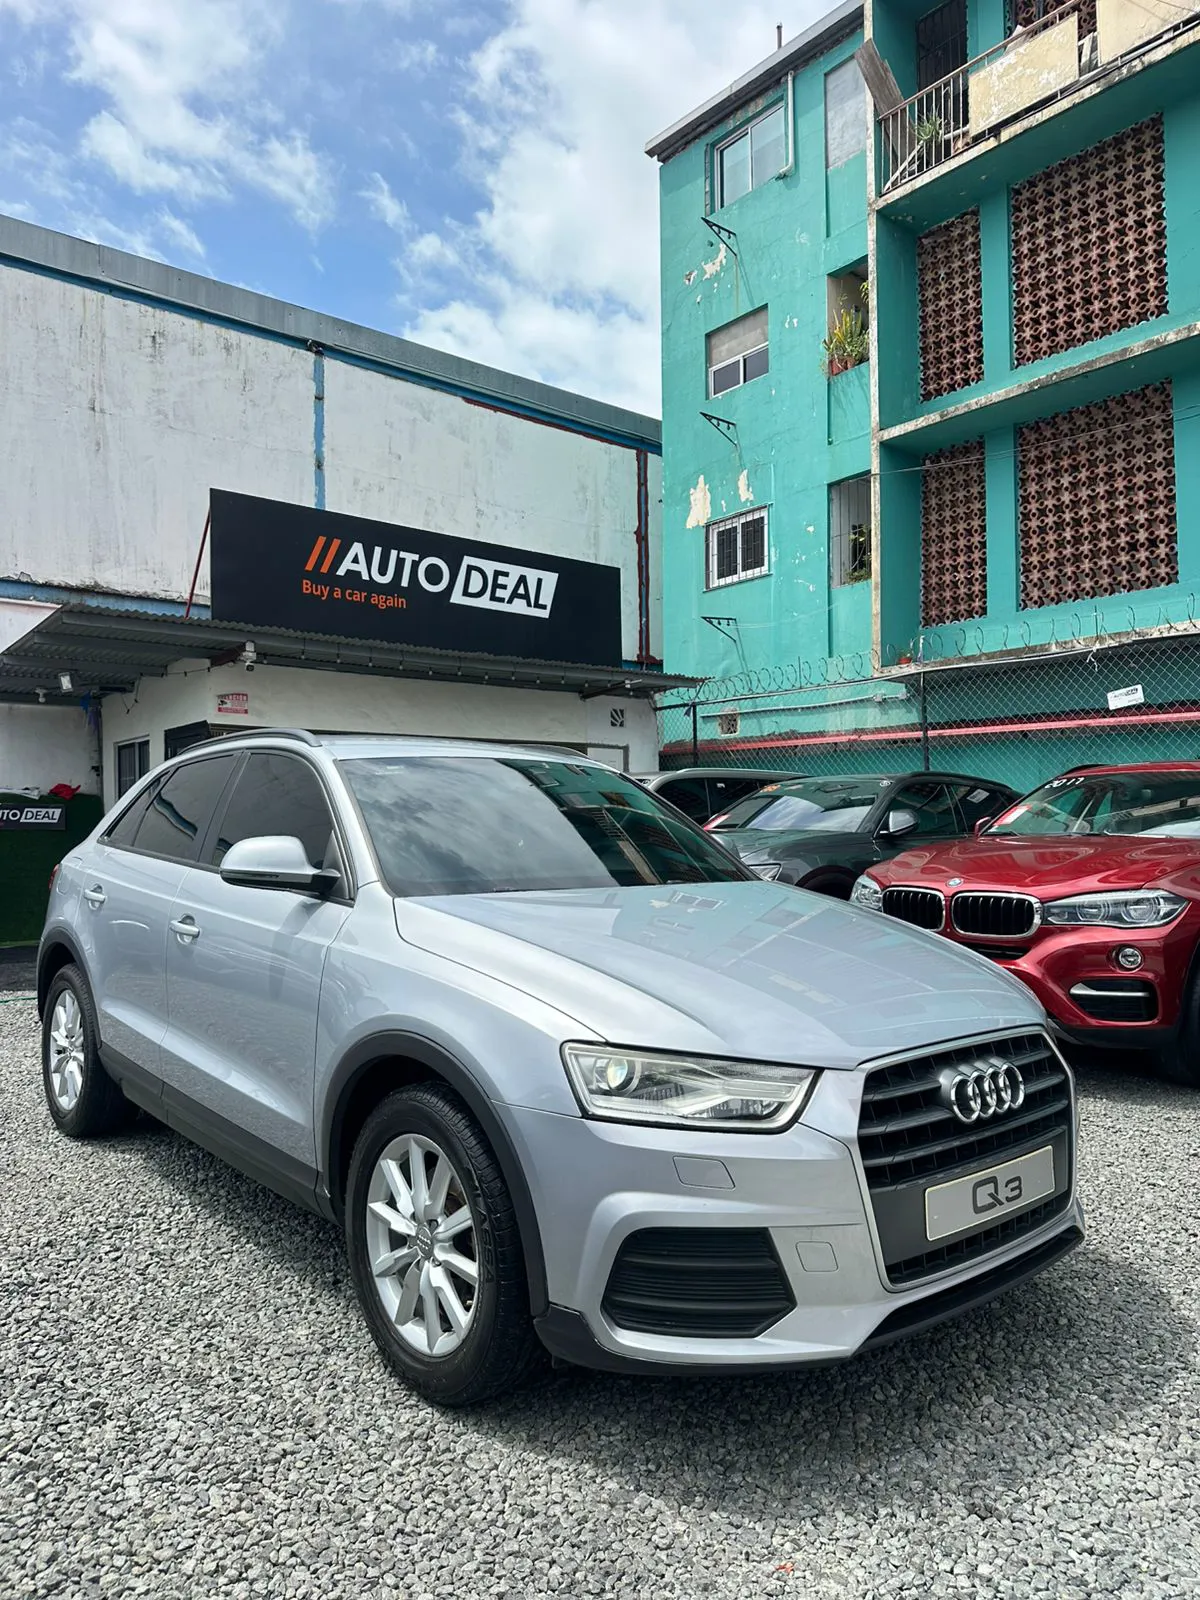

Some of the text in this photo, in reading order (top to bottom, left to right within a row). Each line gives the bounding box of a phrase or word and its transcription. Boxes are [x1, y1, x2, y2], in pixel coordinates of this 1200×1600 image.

[301, 579, 407, 610] Buy a car again
[461, 563, 548, 611] DEAL
[24, 810, 57, 821] DEAL
[972, 1175, 1023, 1215] Q3
